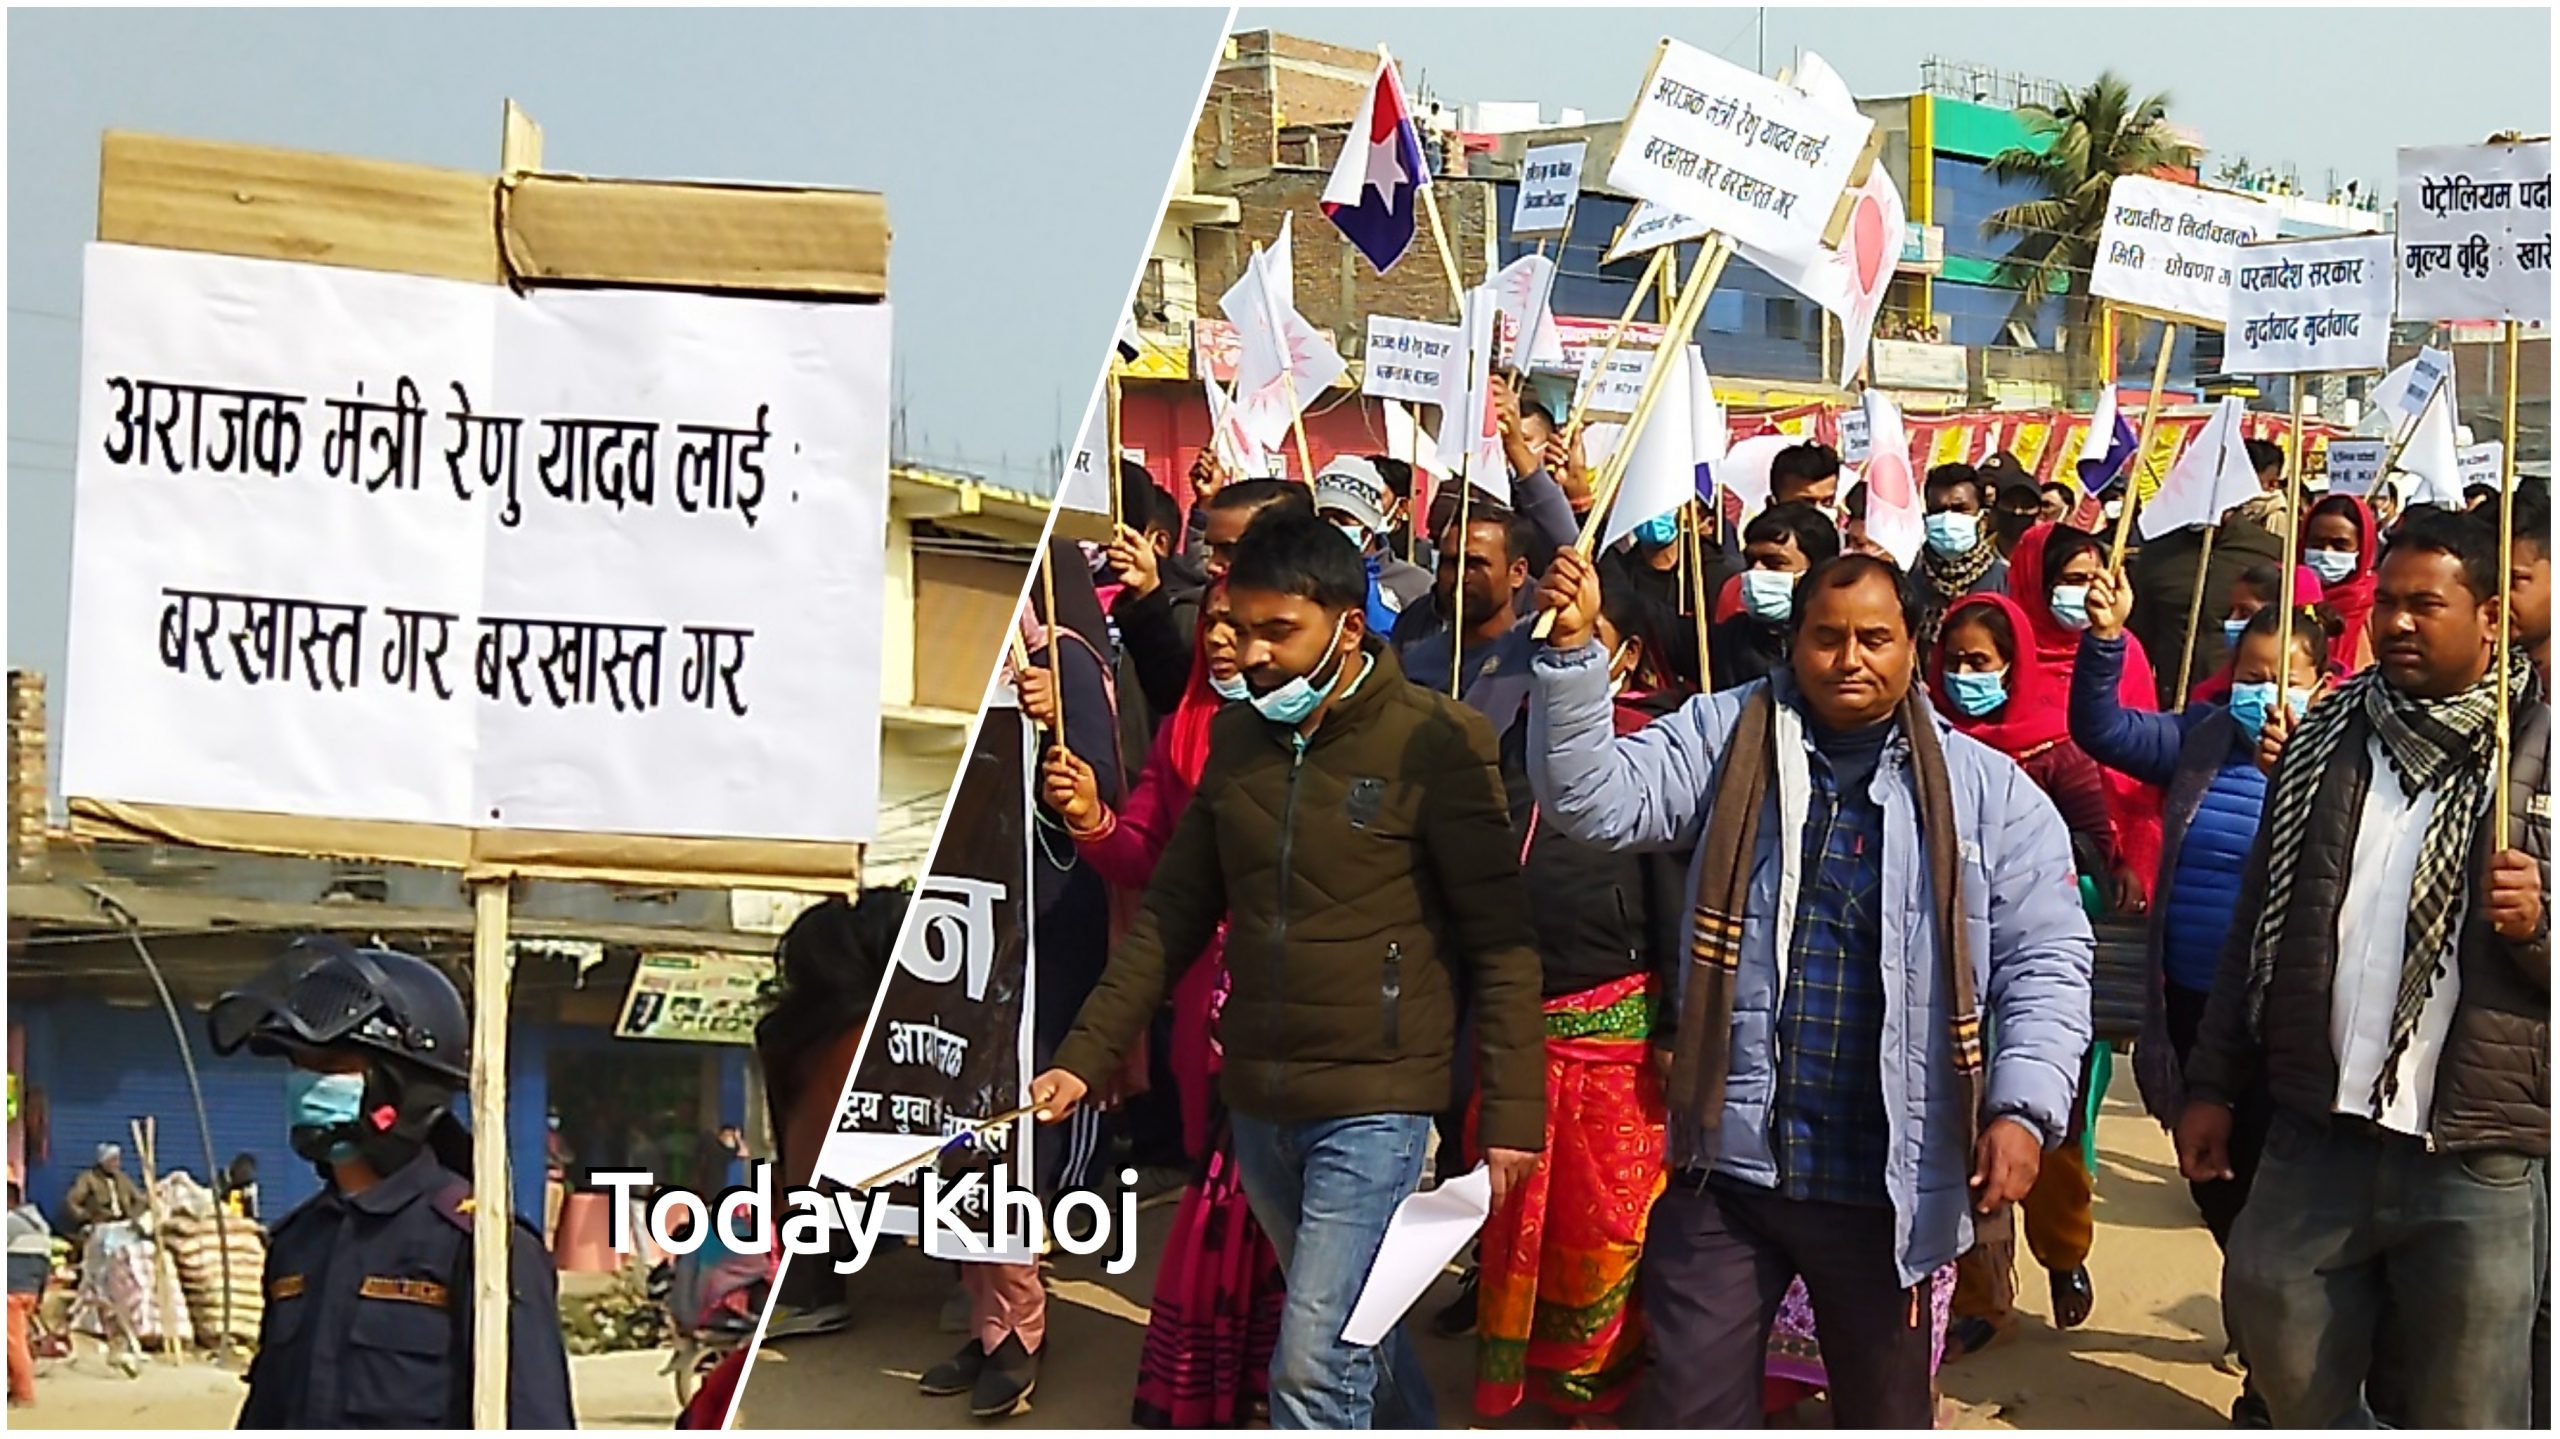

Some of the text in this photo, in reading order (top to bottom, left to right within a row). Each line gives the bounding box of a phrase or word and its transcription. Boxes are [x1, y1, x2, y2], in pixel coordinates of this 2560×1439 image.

[1654, 77, 1708, 116] अराजक
[1737, 102, 1762, 147] रेणु
[1760, 120, 1798, 153] यादव
[1795, 135, 1830, 168] लाई
[1644, 135, 1799, 220] बरखास्त गर बरखास्त गर
[2421, 174, 2513, 219] पेट्रोलियम
[2114, 205, 2258, 248] स्थानीय निर्वाचनको
[2109, 240, 2146, 270] मिति
[2165, 252, 2215, 283] घोषणा
[2240, 257, 2304, 292] परमादेश
[2308, 258, 2364, 288] सरकार
[2405, 243, 2452, 279] मूल्य
[2244, 308, 2363, 350] मुर्दावाद मुर्दावाद
[104, 376, 307, 474] अराजक
[324, 375, 428, 493] मंत्री
[444, 380, 524, 527] रेणु
[538, 418, 660, 513] यादव
[676, 404, 772, 528] लाई
[158, 587, 755, 716] बरखास्त गर बरखास्त गर
[890, 1094, 932, 1134] युवा
